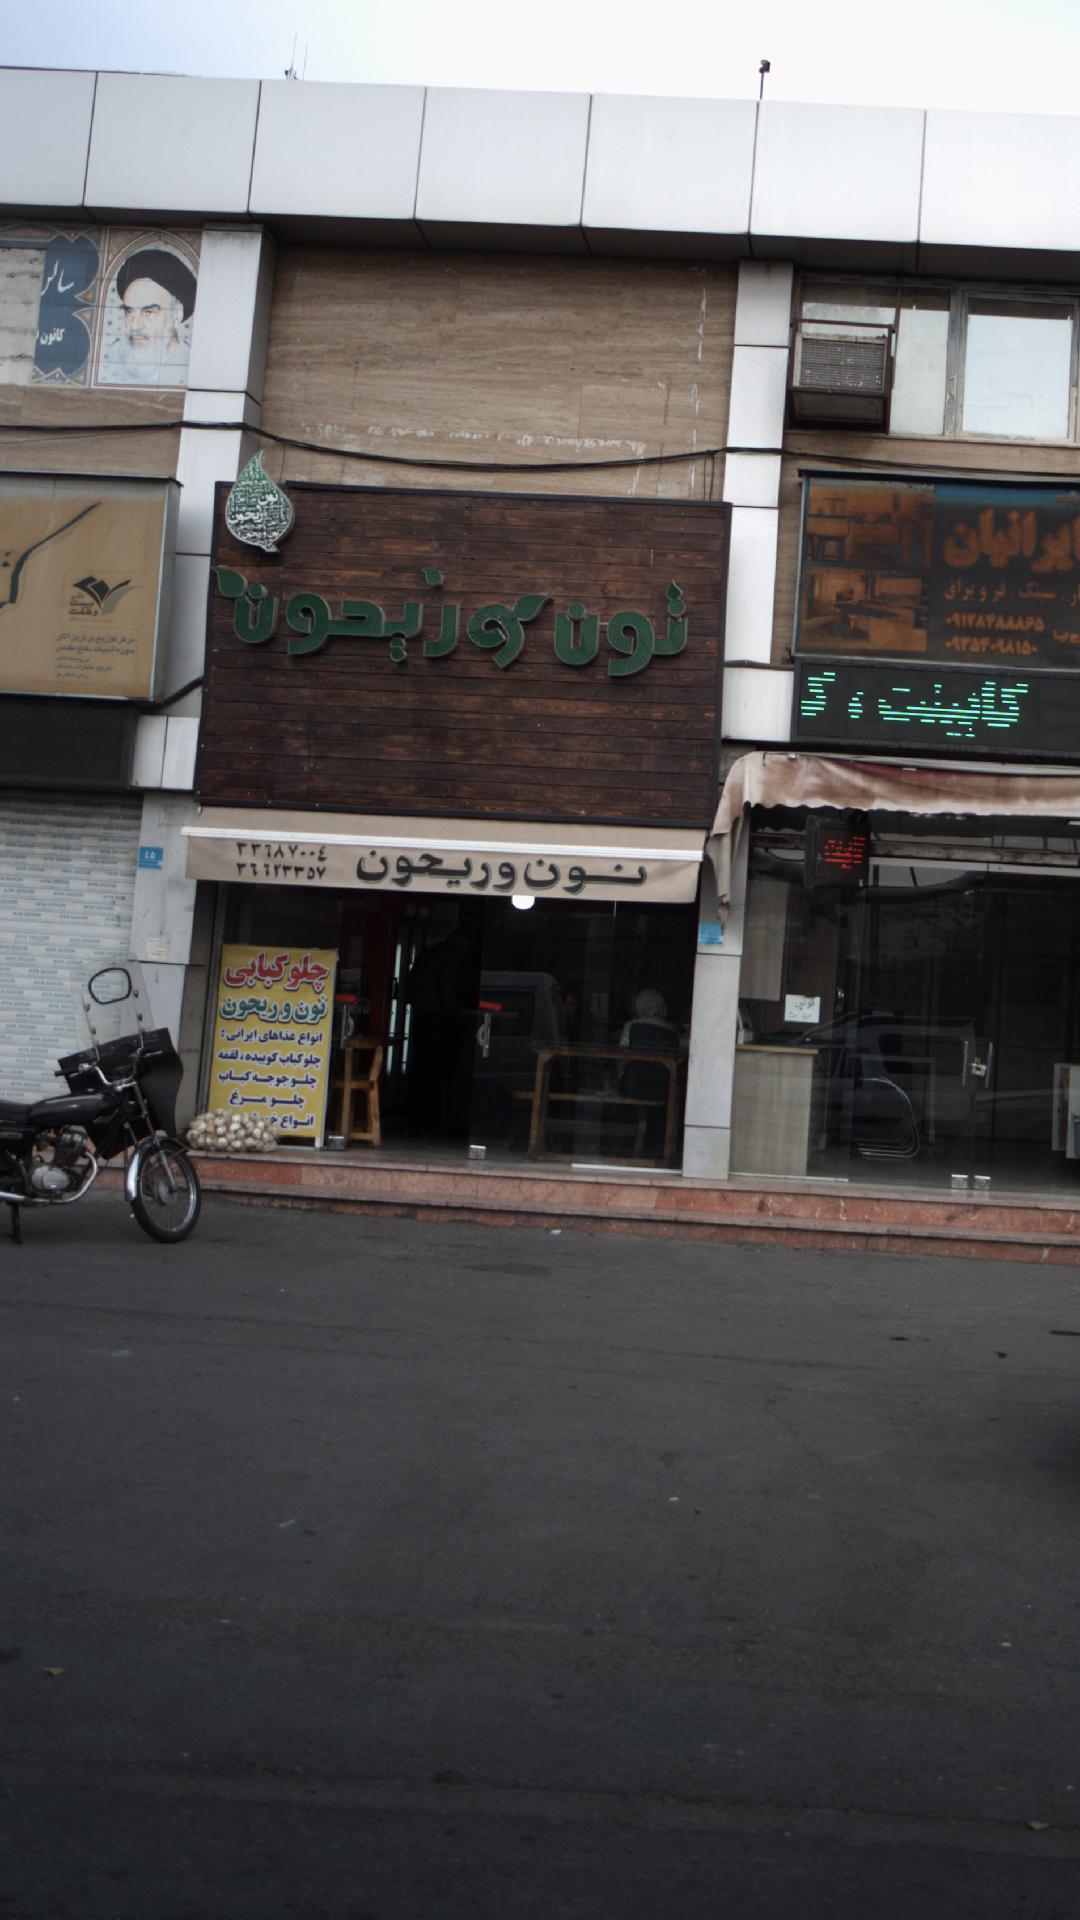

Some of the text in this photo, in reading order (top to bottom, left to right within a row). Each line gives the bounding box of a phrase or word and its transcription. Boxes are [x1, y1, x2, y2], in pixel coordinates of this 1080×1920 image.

[40, 327, 65, 345] کانون
[554, 580, 689, 677] نون
[355, 848, 648, 894] نون و ریحون
[220, 996, 278, 1020] ریحون
[278, 999, 292, 1022] و
[294, 995, 326, 1024] نون
[259, 1029, 296, 1043] غذاهای
[297, 1032, 323, 1046] انواع
[218, 1050, 239, 1060] لقمه
[279, 1053, 304, 1066] کباب
[218, 1070, 252, 1083] کباب
[252, 1073, 290, 1086] جوجه
[230, 1088, 267, 1105] مرغ
[280, 1115, 314, 1129] انواع
